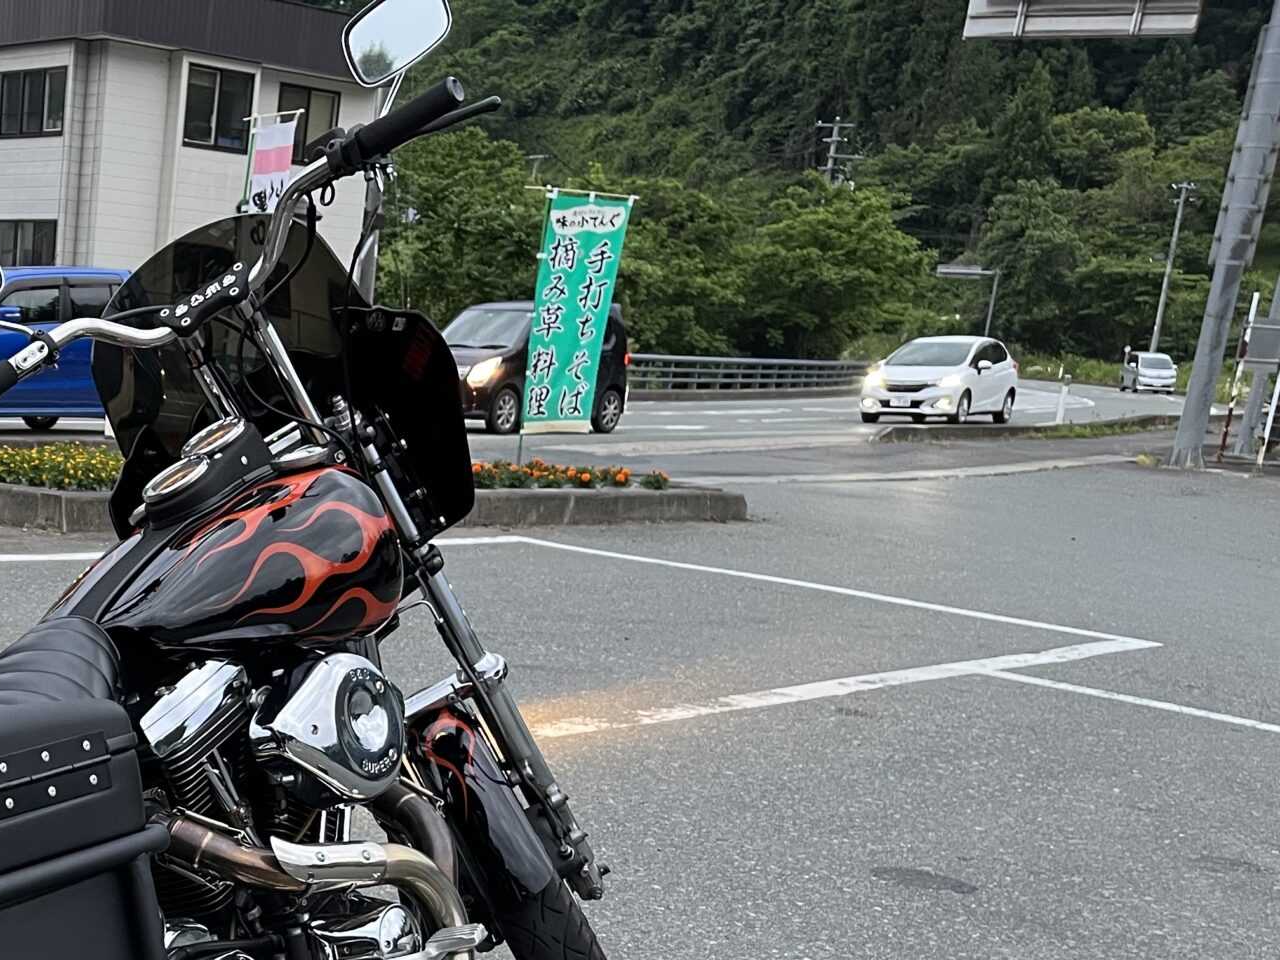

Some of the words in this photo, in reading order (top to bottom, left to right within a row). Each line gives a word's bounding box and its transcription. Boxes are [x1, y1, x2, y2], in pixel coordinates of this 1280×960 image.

[556, 212, 621, 230] 味の小てんぐ
[527, 237, 578, 417] 摘み草料理
[559, 241, 612, 417] 手打ちそば
